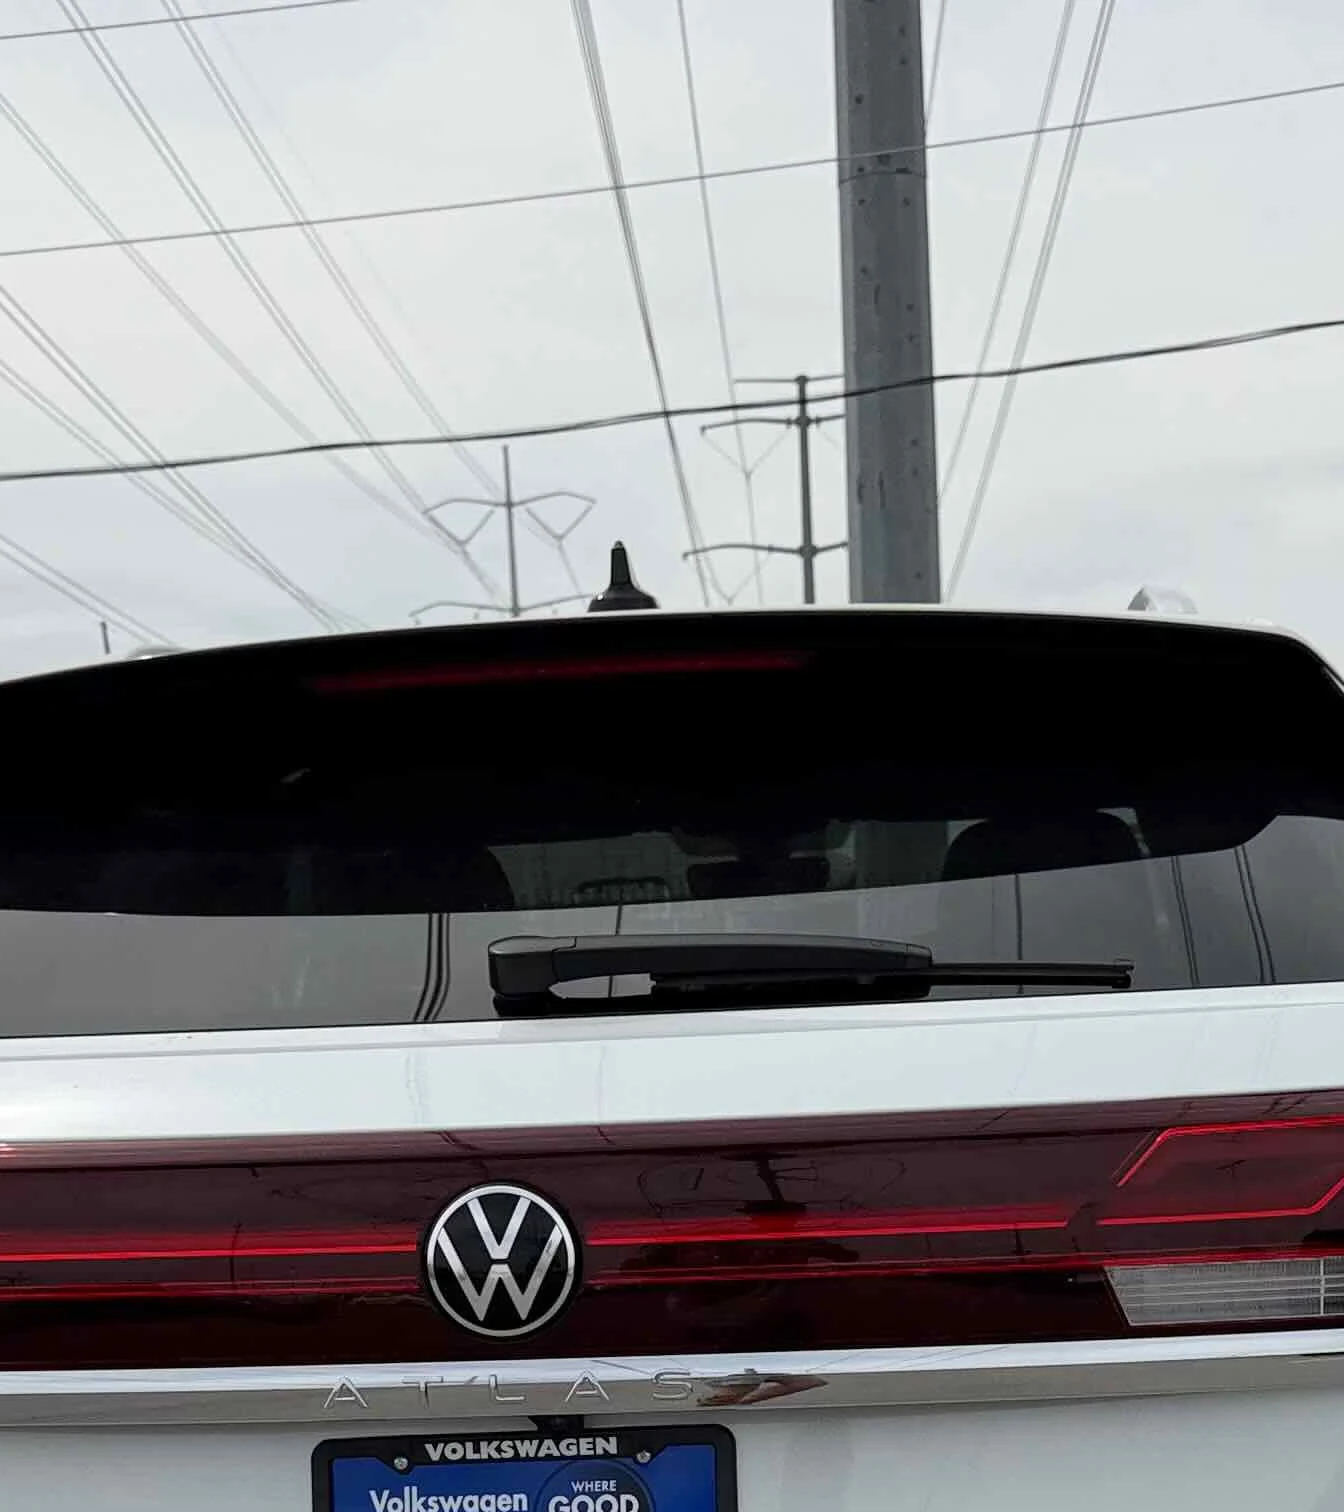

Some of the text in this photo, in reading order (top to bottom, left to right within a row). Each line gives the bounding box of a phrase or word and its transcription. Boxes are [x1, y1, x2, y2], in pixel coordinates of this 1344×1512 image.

[323, 1368, 694, 1408] ATLAS
[424, 1436, 618, 1462] VOLKSWAGEN
[570, 1479, 617, 1493] WHERE
